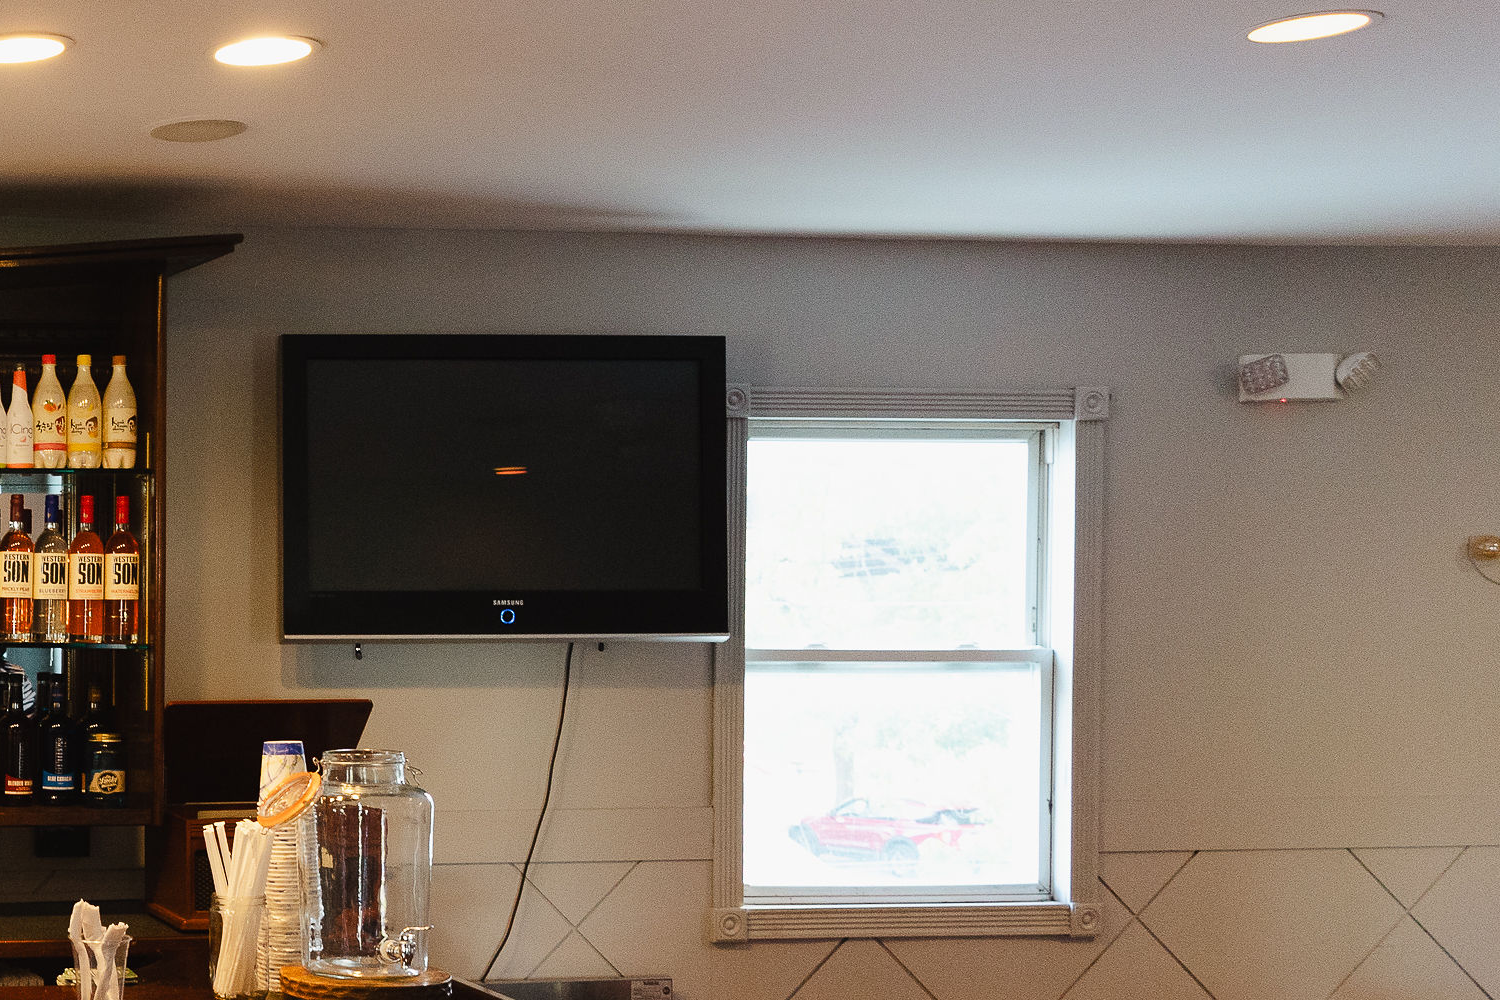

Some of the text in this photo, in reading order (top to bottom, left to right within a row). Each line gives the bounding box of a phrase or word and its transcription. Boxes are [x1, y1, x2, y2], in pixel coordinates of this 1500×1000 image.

[3, 560, 30, 583] SON
[41, 562, 66, 585] SON
[77, 563, 102, 585] SON
[113, 563, 138, 585] SON
